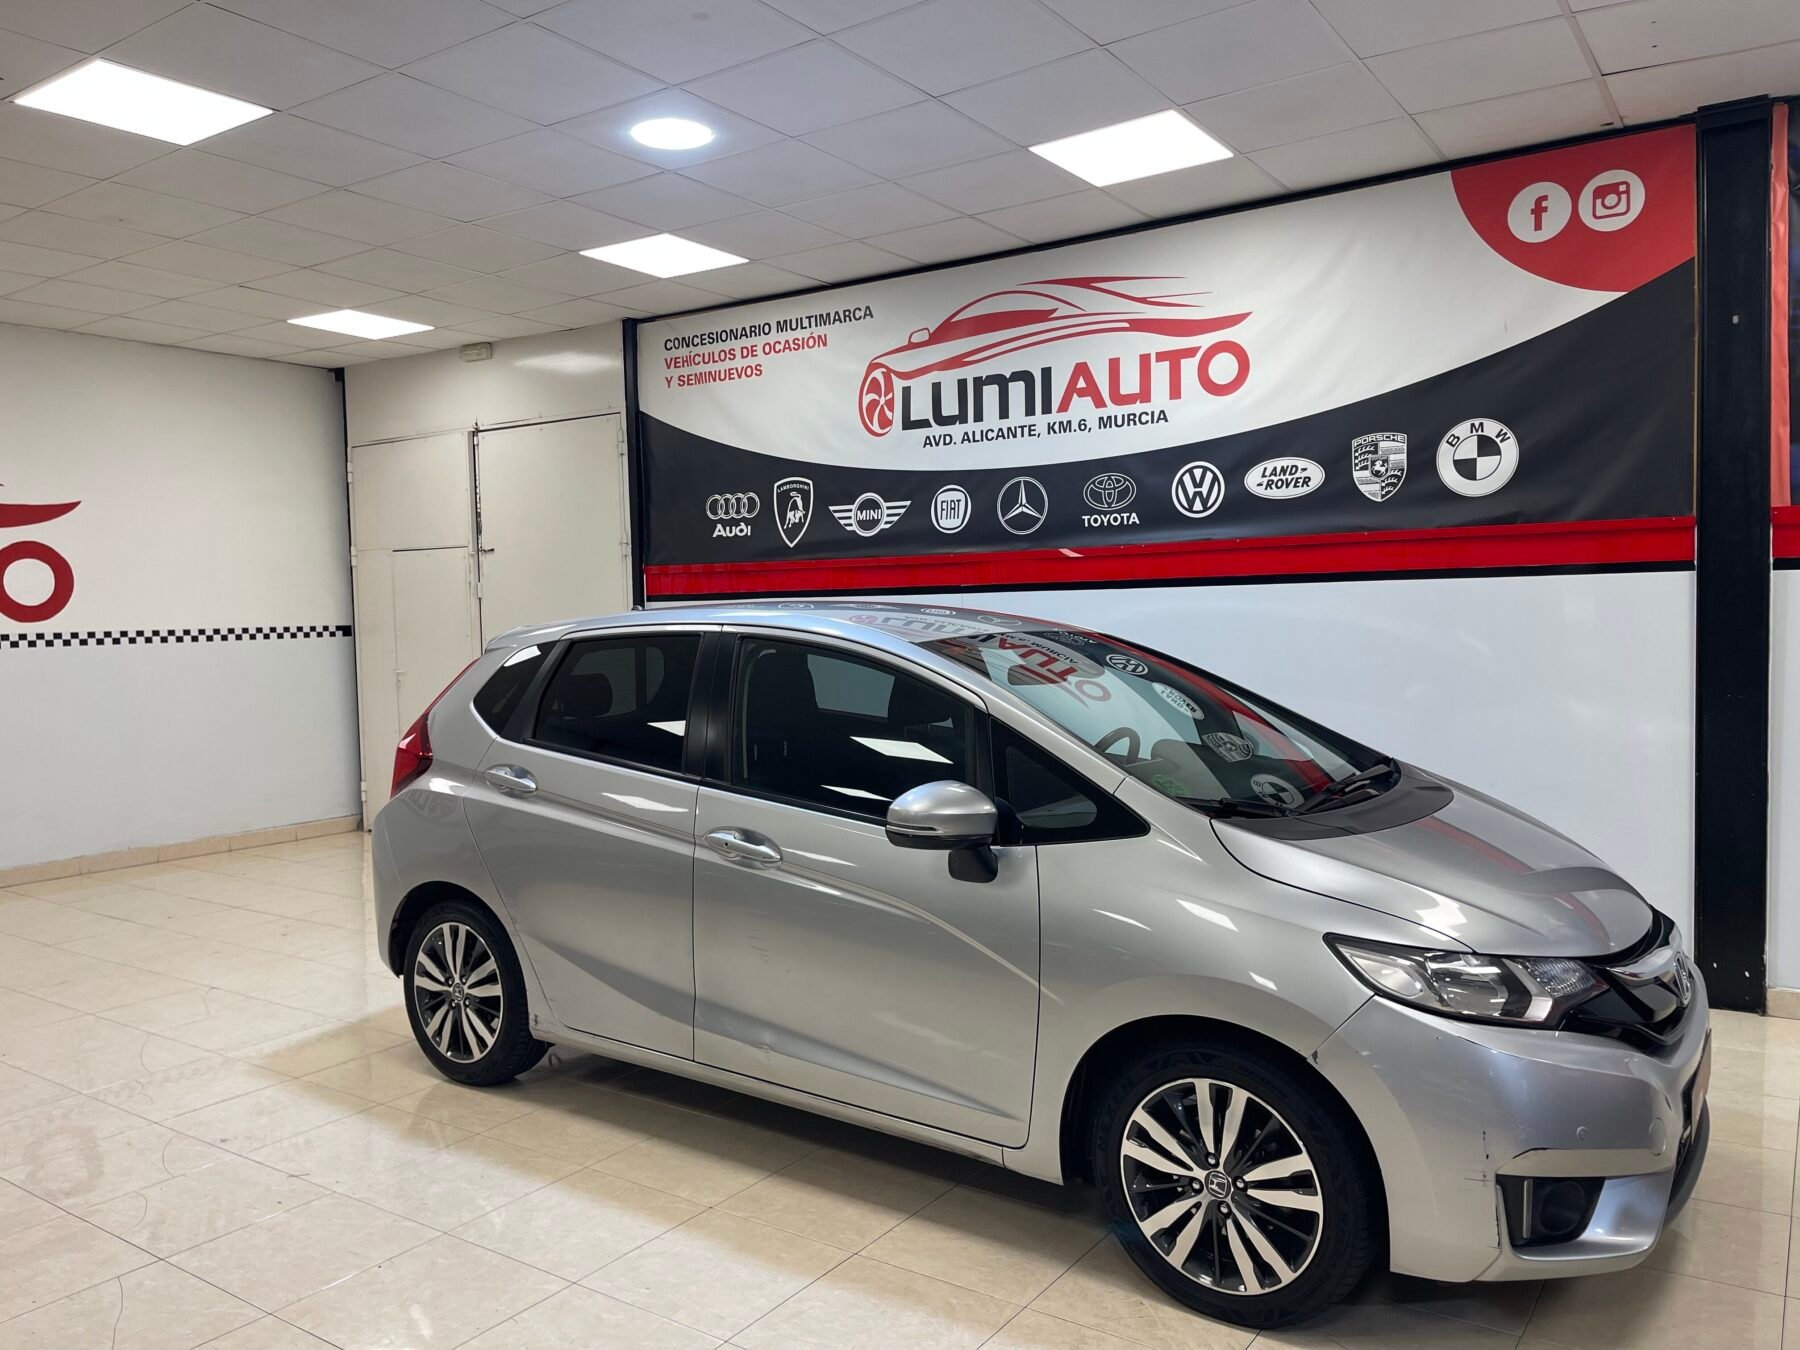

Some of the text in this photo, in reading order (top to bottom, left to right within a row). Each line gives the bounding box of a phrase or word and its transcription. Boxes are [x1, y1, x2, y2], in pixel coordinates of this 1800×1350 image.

[664, 305, 874, 352] CONCESIONARIO MULTIMARCA
[664, 332, 828, 370] VEHÍCULOS DE OCASIÓN
[665, 363, 763, 389] Y SEMINUEVOS
[922, 409, 1169, 449] AVD. ALICANTE, KM.6, MURCIA
[1445, 421, 1511, 448] BMW
[1353, 433, 1406, 447] PORSCHE
[1260, 464, 1299, 478] LAND
[1264, 475, 1312, 491] ROVER
[856, 508, 882, 522] MINI
[939, 498, 963, 521] FIAT
[1081, 512, 1140, 528] TOYOTA
[712, 522, 751, 538] Audi
